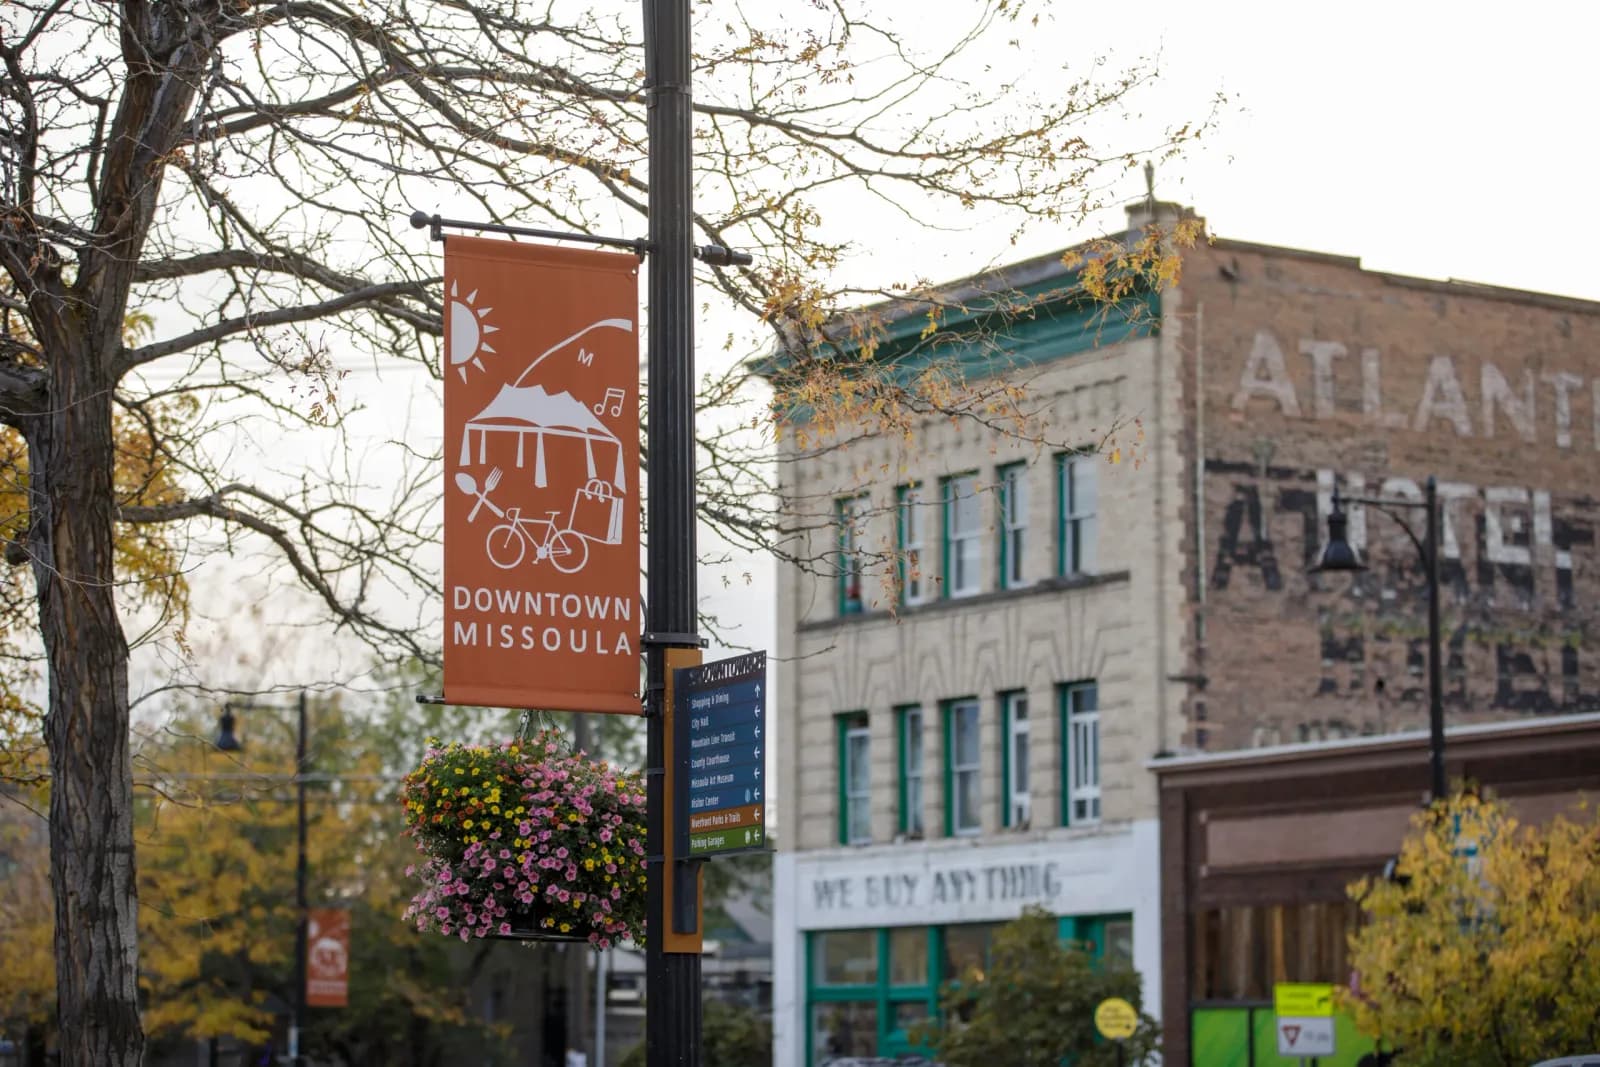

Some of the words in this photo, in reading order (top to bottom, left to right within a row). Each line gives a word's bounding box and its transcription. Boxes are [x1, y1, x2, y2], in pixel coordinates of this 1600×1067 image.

[577, 347, 594, 368] M
[453, 585, 631, 621] DOWNTOWN
[453, 621, 632, 656] MISSOULA
[691, 697, 711, 709] Shopping
[715, 693, 729, 704] Dining
[691, 718, 700, 730] City
[700, 715, 709, 727] Hall
[691, 736, 709, 748] Mountain
[710, 735, 720, 745] Line
[720, 731, 736, 743] Transit
[691, 757, 705, 769] County
[706, 754, 730, 767] Courthouse
[691, 776, 709, 788] Missoula
[717, 774, 734, 784] Museum
[691, 797, 705, 808] Visitor
[705, 796, 719, 806] Center
[691, 815, 712, 828] Riverfront
[712, 814, 724, 825] Parks
[728, 812, 741, 823] Trails
[691, 837, 707, 850] Parking
[707, 836, 725, 847] Garages
[812, 876, 854, 910] WE
[864, 873, 920, 907] BUY
